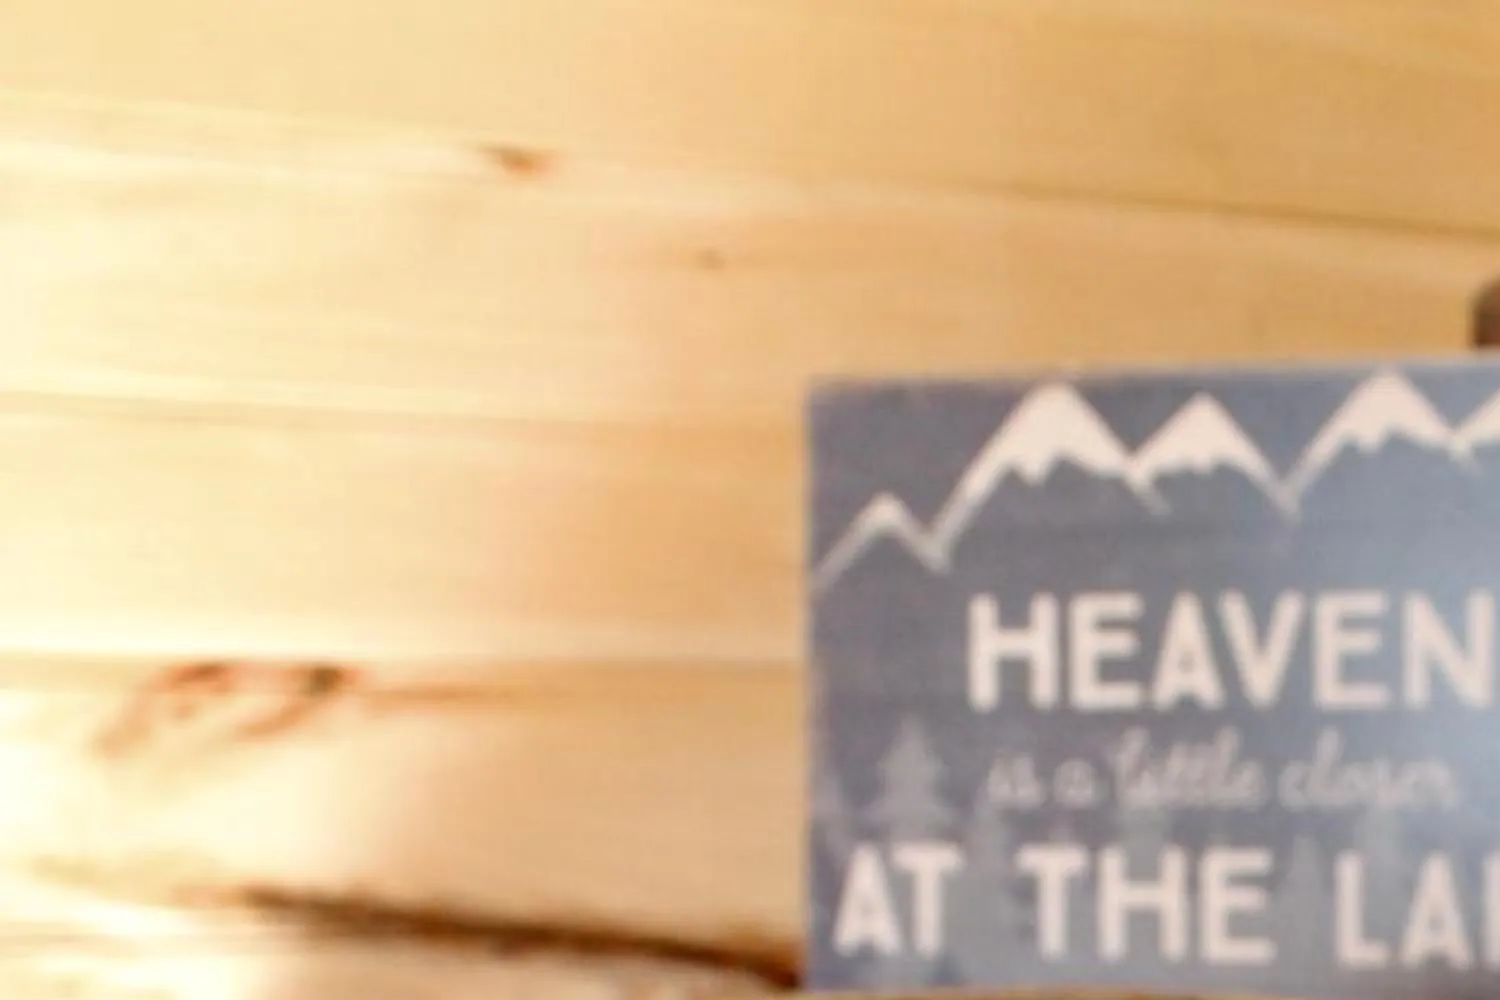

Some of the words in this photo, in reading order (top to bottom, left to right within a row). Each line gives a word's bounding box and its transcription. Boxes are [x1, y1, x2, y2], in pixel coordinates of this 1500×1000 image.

[966, 590, 1498, 712] HEAVEN
[985, 752, 1042, 806] is
[1053, 756, 1097, 806] a
[1111, 725, 1266, 808] little
[833, 842, 964, 957] AT
[1016, 844, 1278, 966] THE
